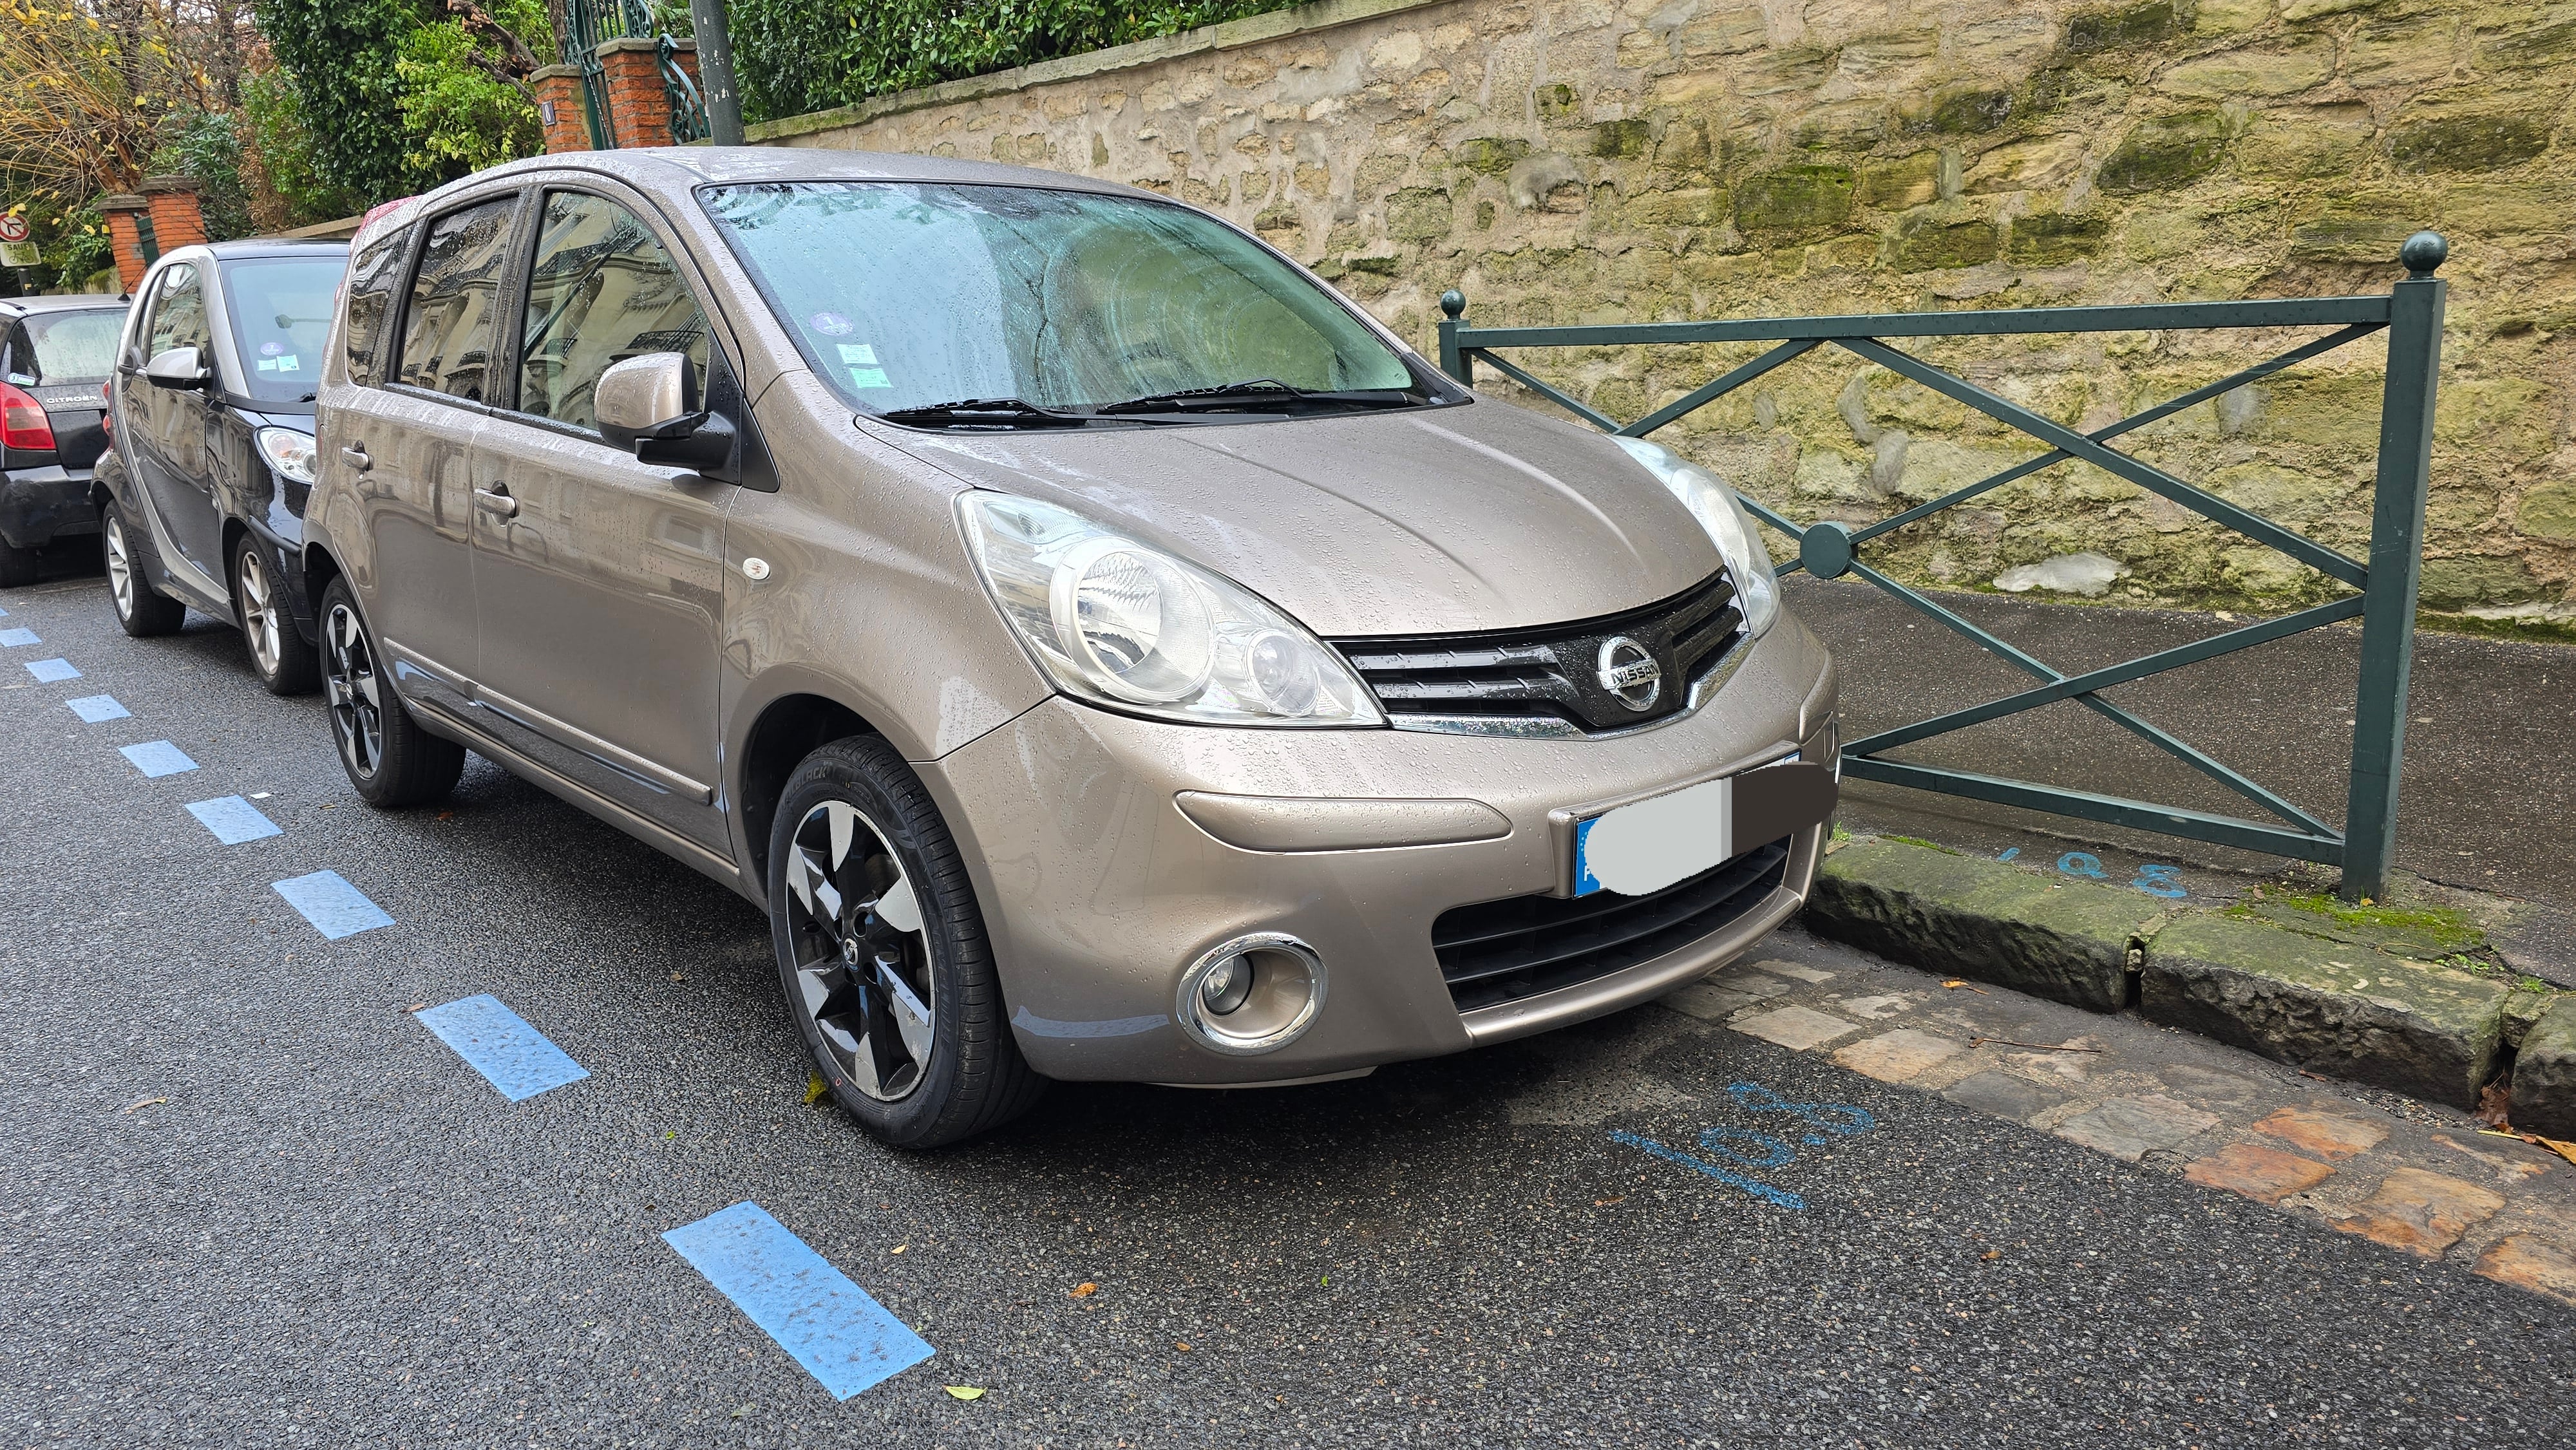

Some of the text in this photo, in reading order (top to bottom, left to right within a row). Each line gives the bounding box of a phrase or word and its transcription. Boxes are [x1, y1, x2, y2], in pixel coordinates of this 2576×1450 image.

[545, 104, 551, 122] 8
[46, 395, 98, 404] CITROËN
[1610, 664, 1659, 684] NISSAN
